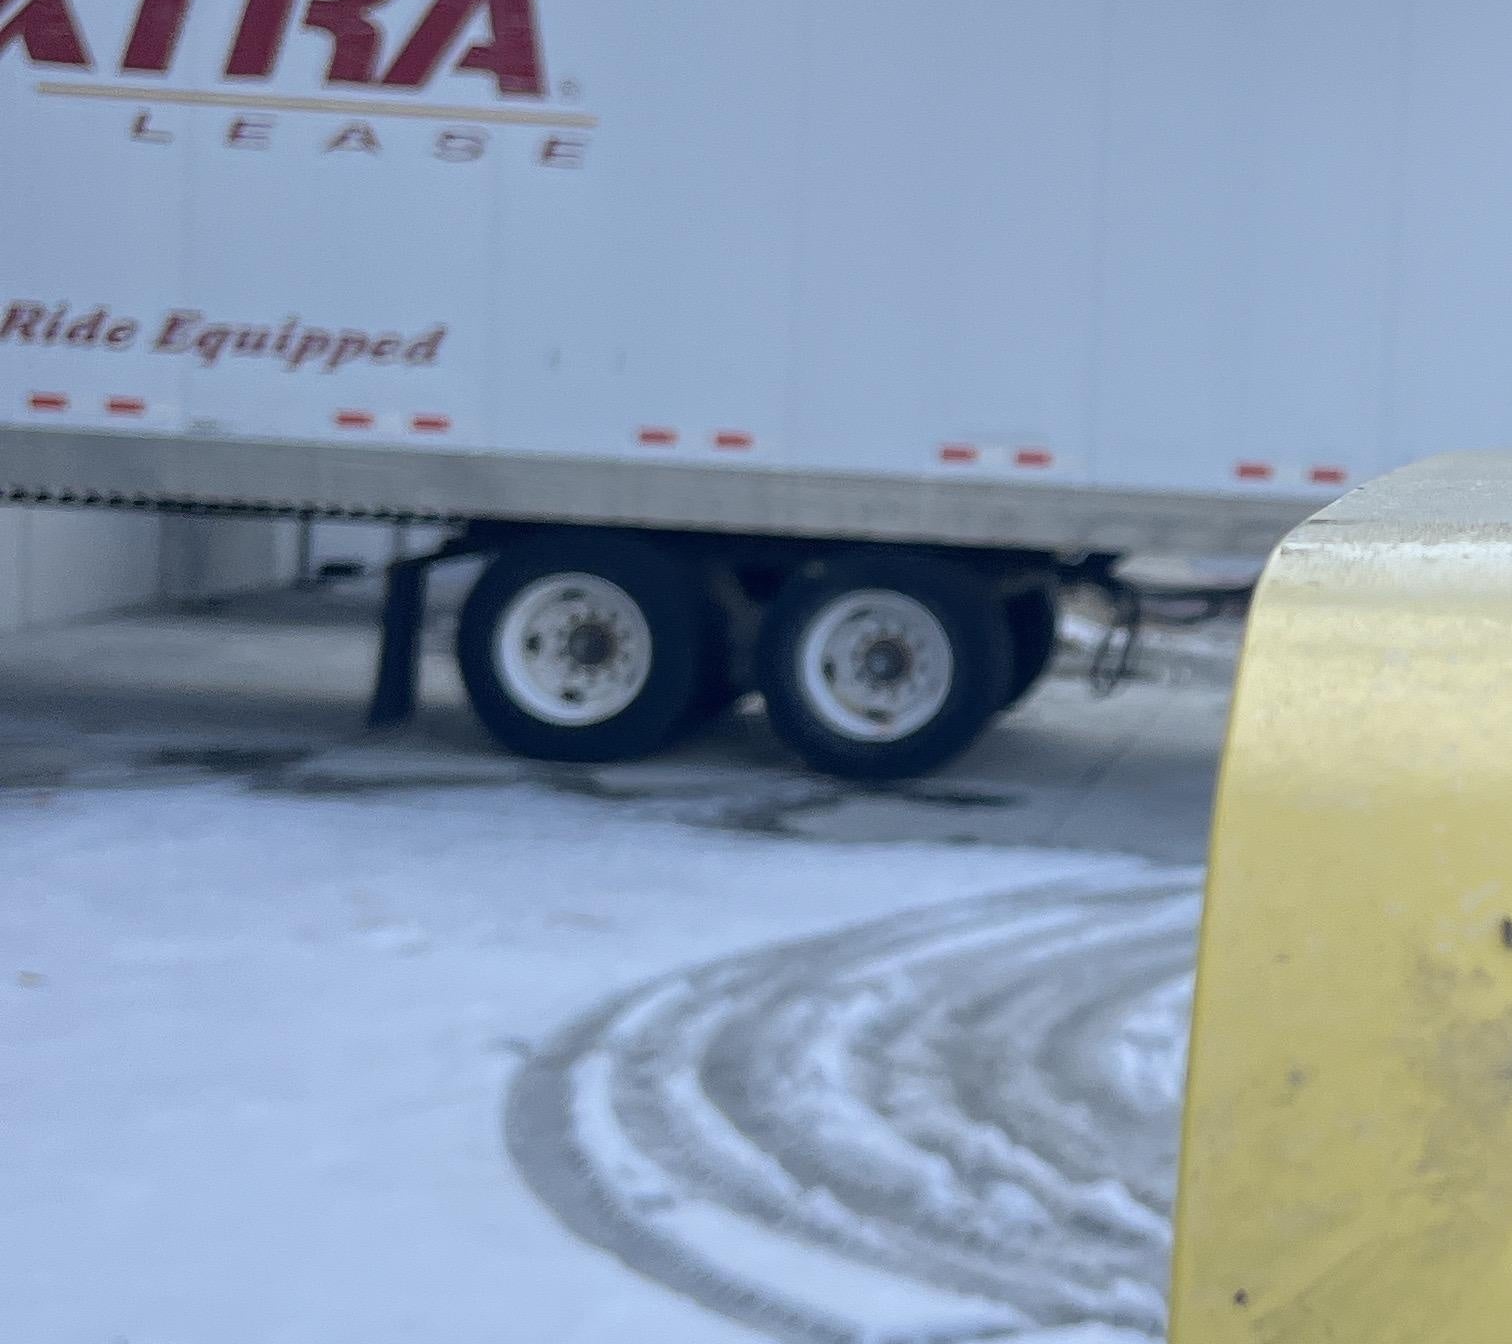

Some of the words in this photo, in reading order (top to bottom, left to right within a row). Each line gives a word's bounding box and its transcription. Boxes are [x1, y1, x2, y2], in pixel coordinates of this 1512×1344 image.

[130, 108, 590, 167] LEASE
[0, 300, 138, 350] Ride
[151, 309, 447, 371] Equipped
